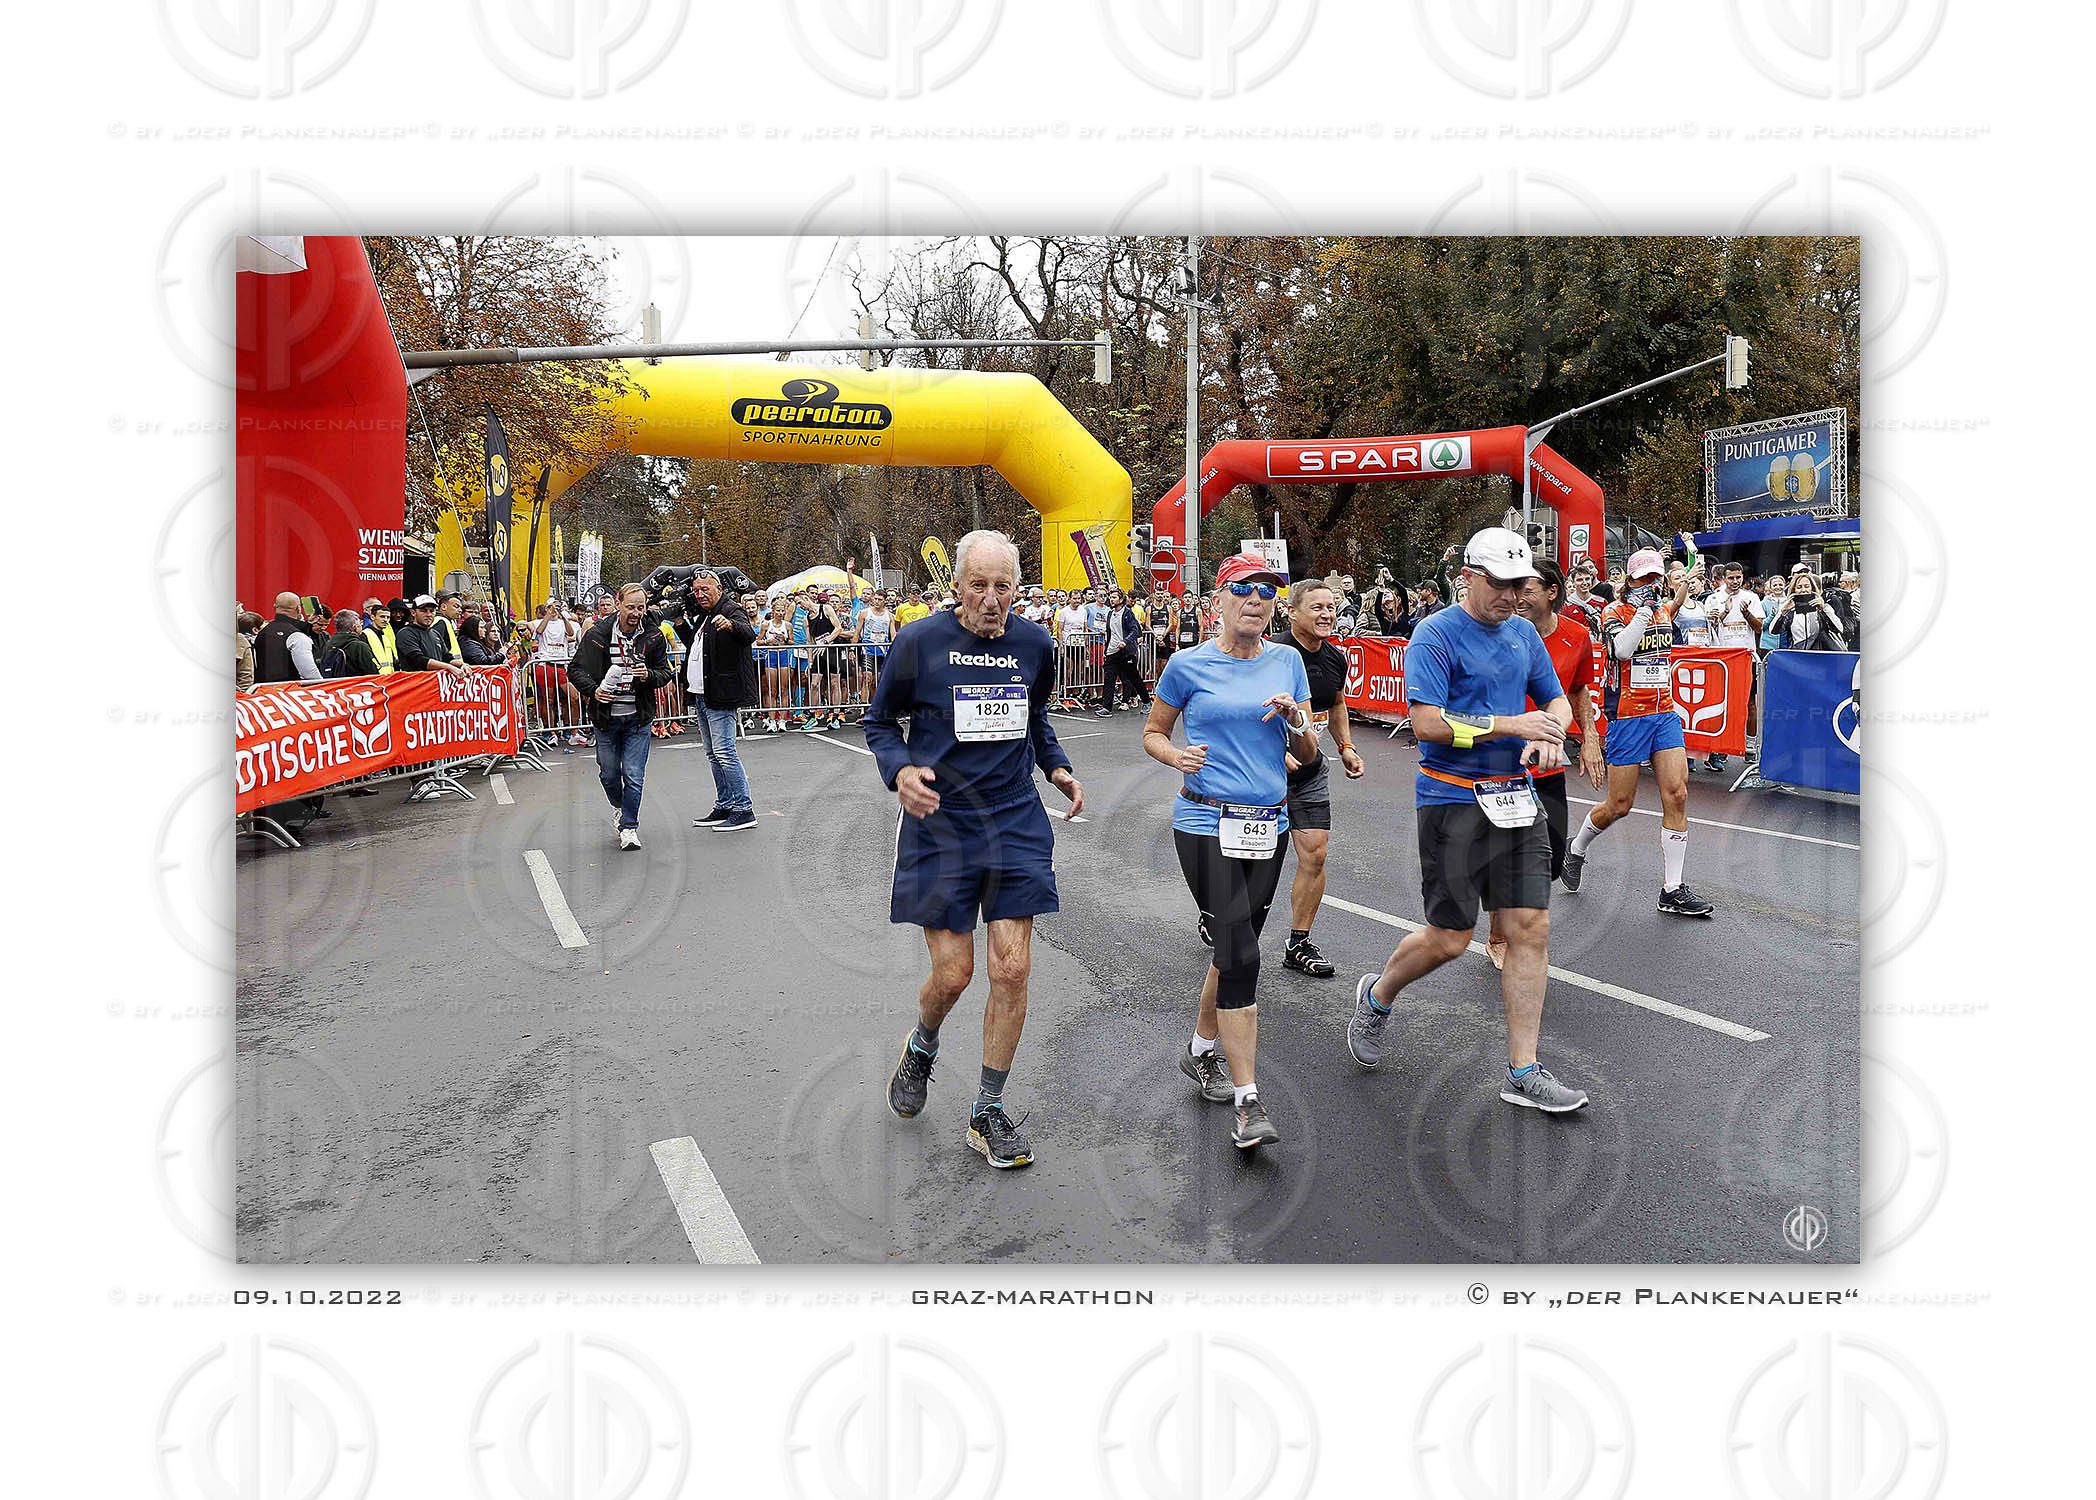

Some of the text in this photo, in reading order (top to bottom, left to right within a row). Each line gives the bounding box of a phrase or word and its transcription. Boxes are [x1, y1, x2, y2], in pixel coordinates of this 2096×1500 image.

[742, 431, 882, 447] SPORTNAHRUNG
[1724, 431, 1817, 462] PUNTIGAMER
[1298, 447, 1418, 471] SPAR
[358, 528, 404, 546] WIENE
[358, 573, 387, 581] VIENNA
[948, 651, 1019, 669] Reebok
[1369, 674, 1407, 703] STÄDTI
[975, 702, 1010, 716] 1820
[404, 709, 490, 750] STÄDTISCHE
[1495, 795, 1515, 807] 644
[1243, 822, 1267, 836] 643
